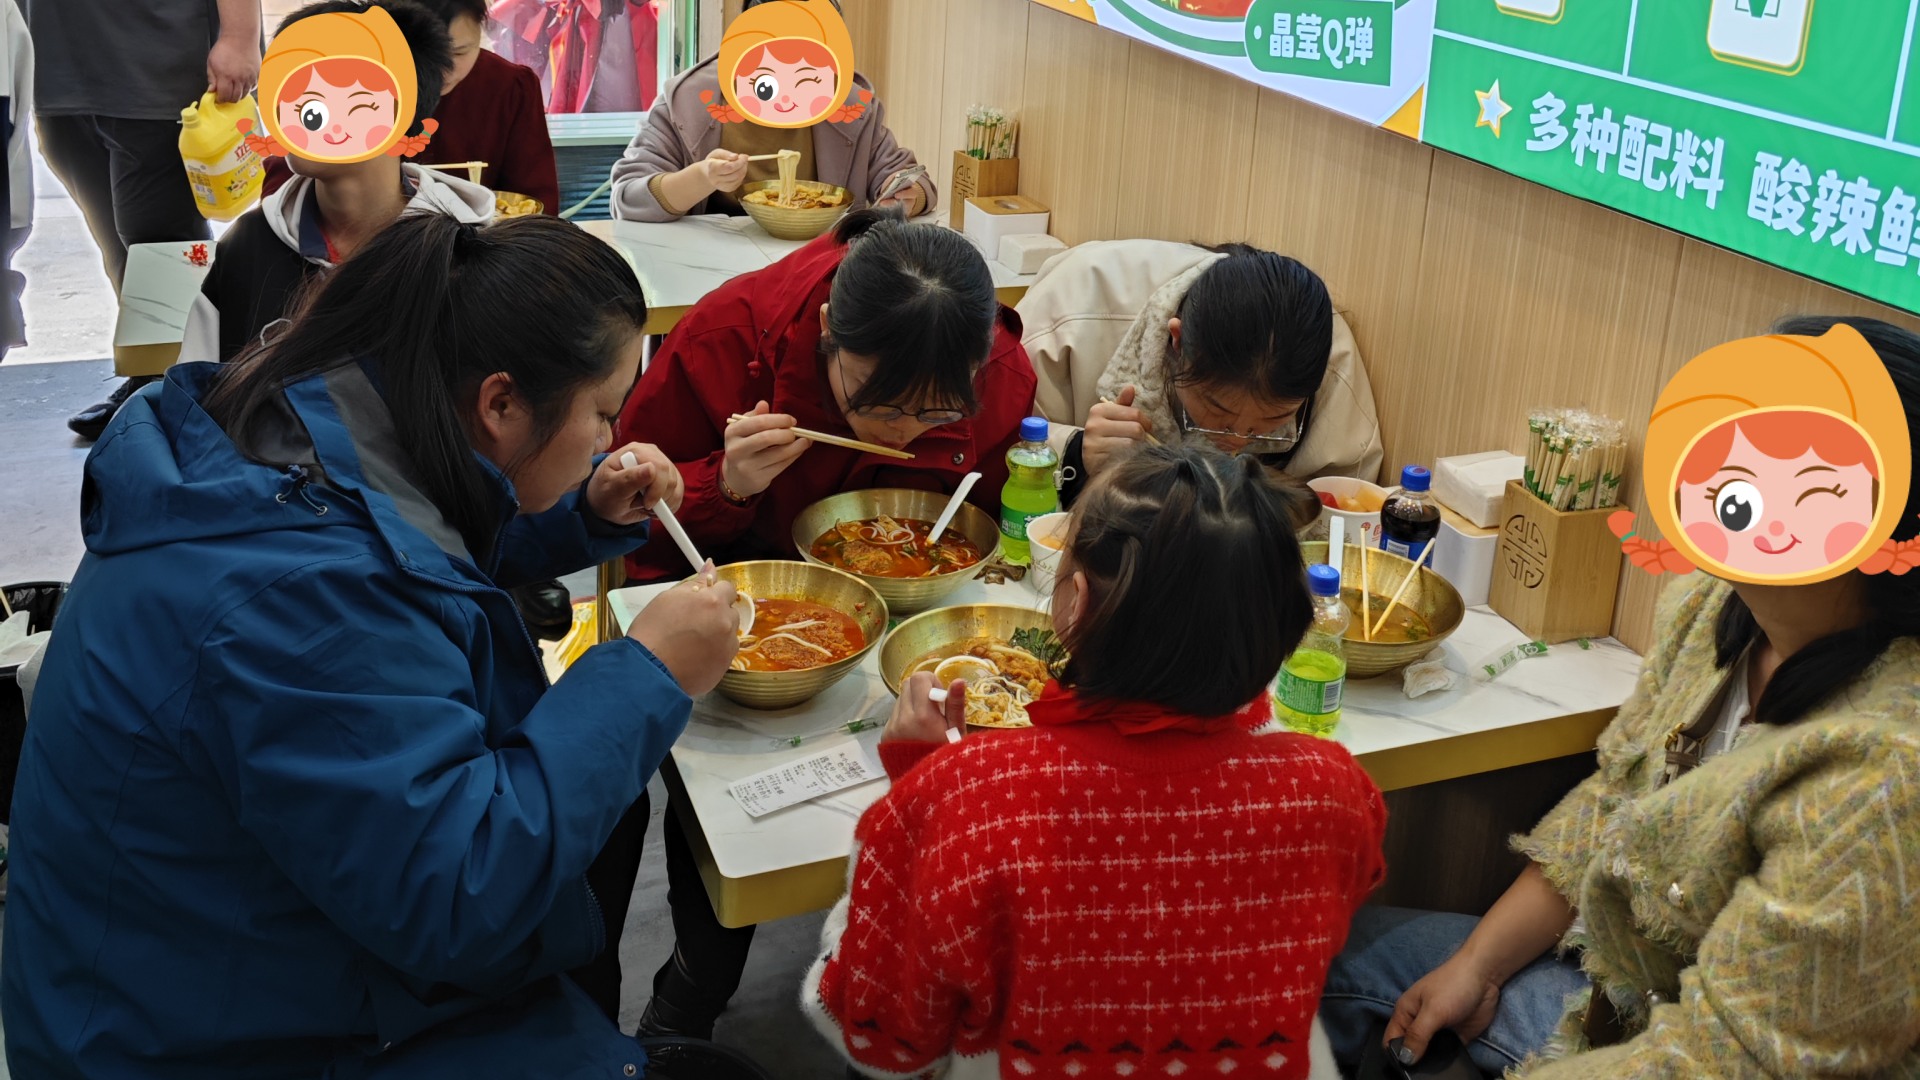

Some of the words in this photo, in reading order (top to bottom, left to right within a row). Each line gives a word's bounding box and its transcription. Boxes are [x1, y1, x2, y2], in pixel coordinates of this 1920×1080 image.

[1269, 13, 1374, 69] 晶莹Q弹
[1526, 91, 1725, 209] 多种配料
